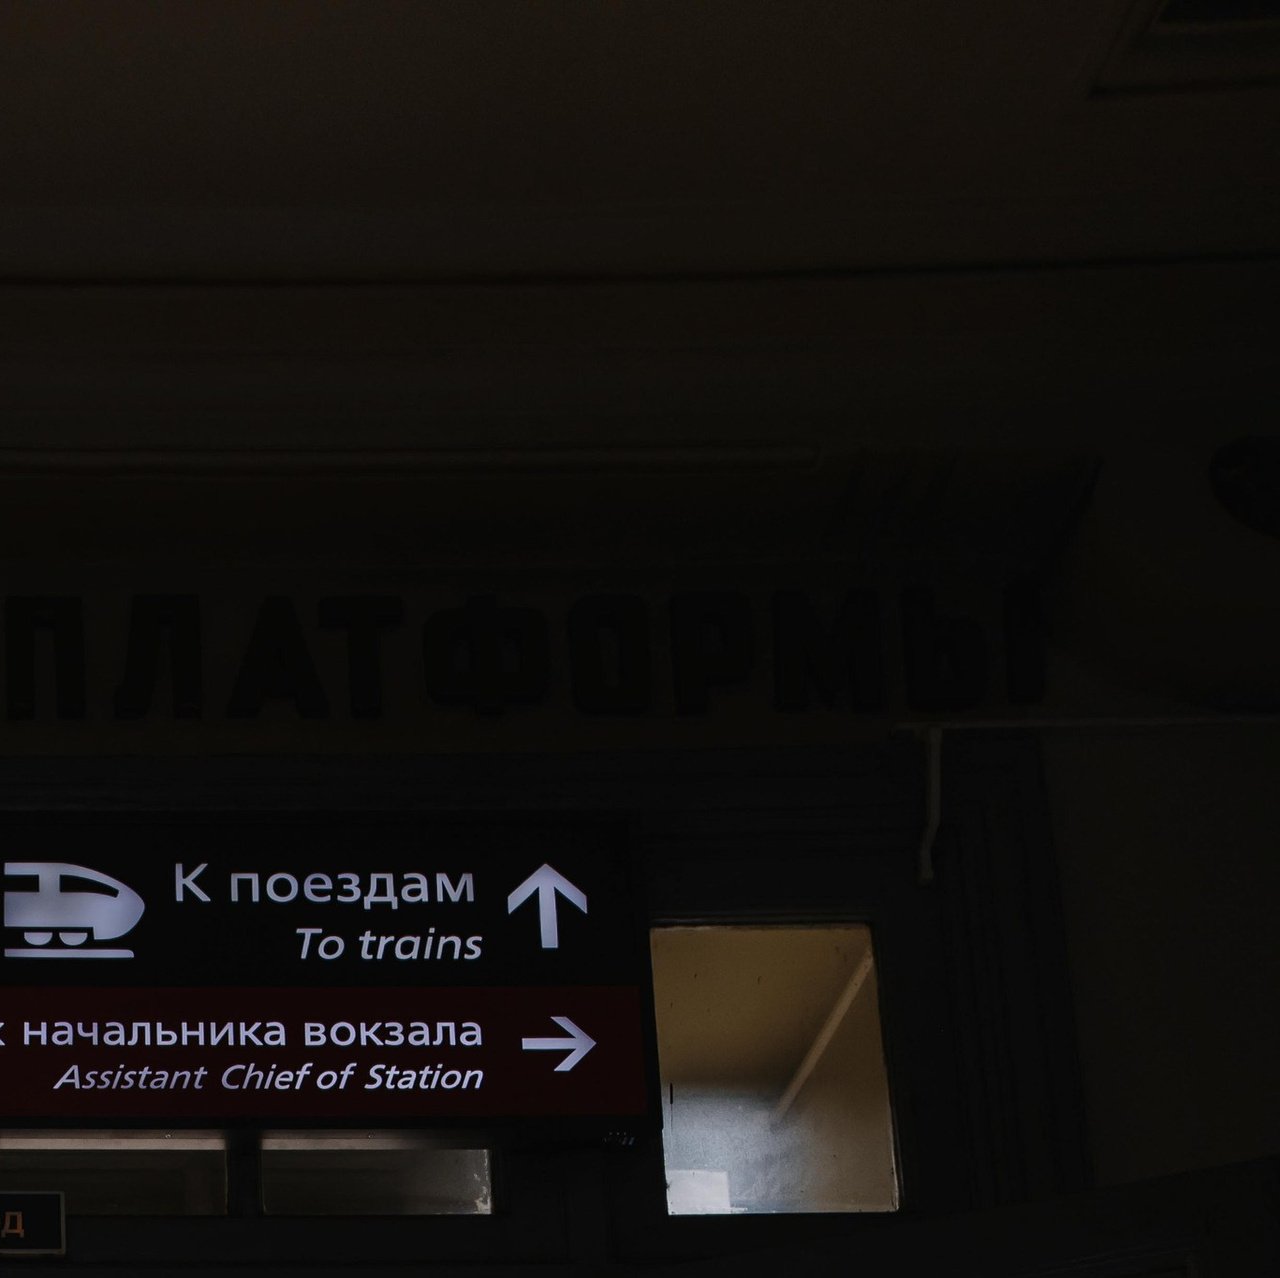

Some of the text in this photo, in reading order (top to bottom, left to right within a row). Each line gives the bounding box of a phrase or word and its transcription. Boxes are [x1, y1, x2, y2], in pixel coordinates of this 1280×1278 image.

[4, 577, 1046, 721] ПЛАТФОРМЫ
[175, 862, 475, 910] К поездам
[295, 928, 483, 960] To trains
[23, 1021, 286, 1046] начальника
[304, 1021, 482, 1047] вокзала
[53, 1062, 484, 1090] Assistant Chief of Station
